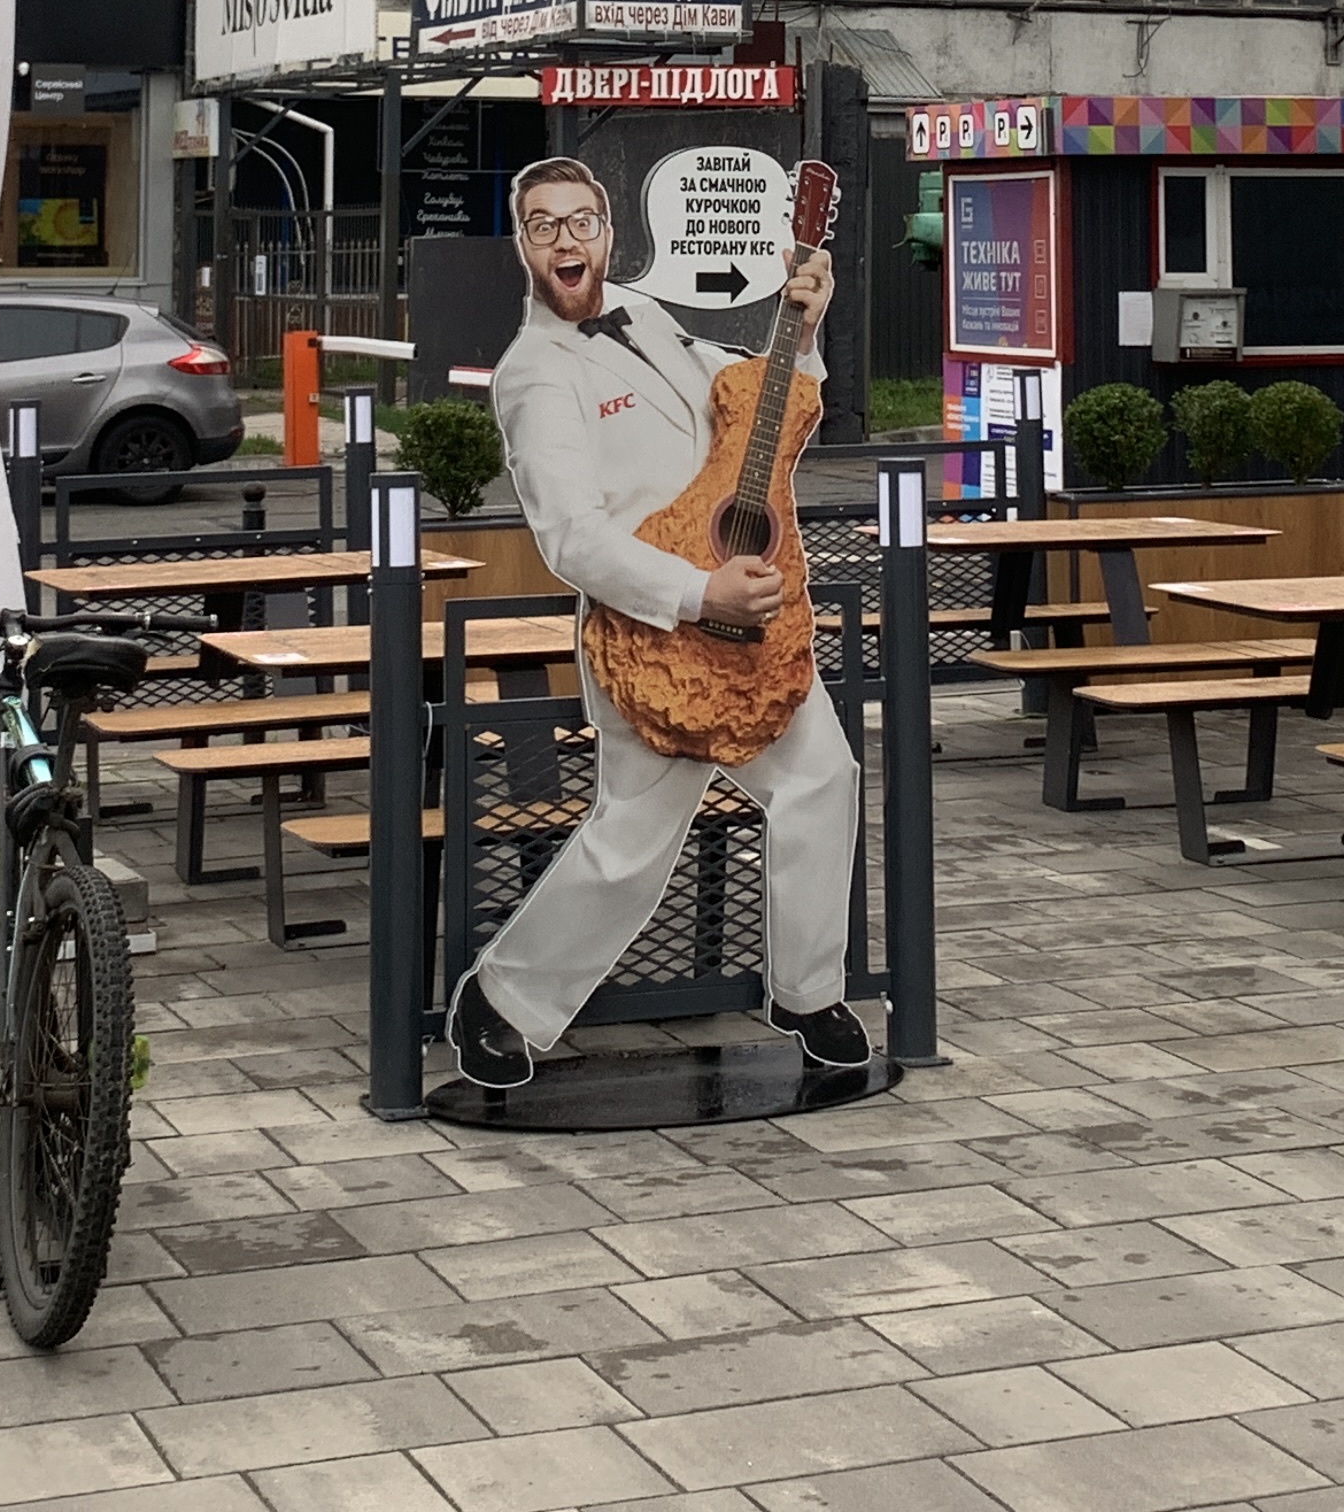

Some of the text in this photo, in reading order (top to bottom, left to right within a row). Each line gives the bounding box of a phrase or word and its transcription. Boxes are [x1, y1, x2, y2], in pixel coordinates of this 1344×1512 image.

[595, 4, 736, 28] вхід через Дім Кави
[551, 66, 780, 104] ДВЕРІ-ПІДЛОГА
[696, 152, 751, 172] ЗАВІТАЙ
[680, 177, 766, 193] ЗА СМАЧНОЮ
[685, 198, 760, 214] КУРОЧКОЮ
[685, 219, 760, 237] ДО НОВОГО
[671, 240, 775, 256] РЕСТОРАНУ KFC
[961, 240, 1021, 265] ТЕХНІКА
[962, 271, 1022, 292] ЖИВЕ ТУТ
[598, 392, 636, 419] KFC
